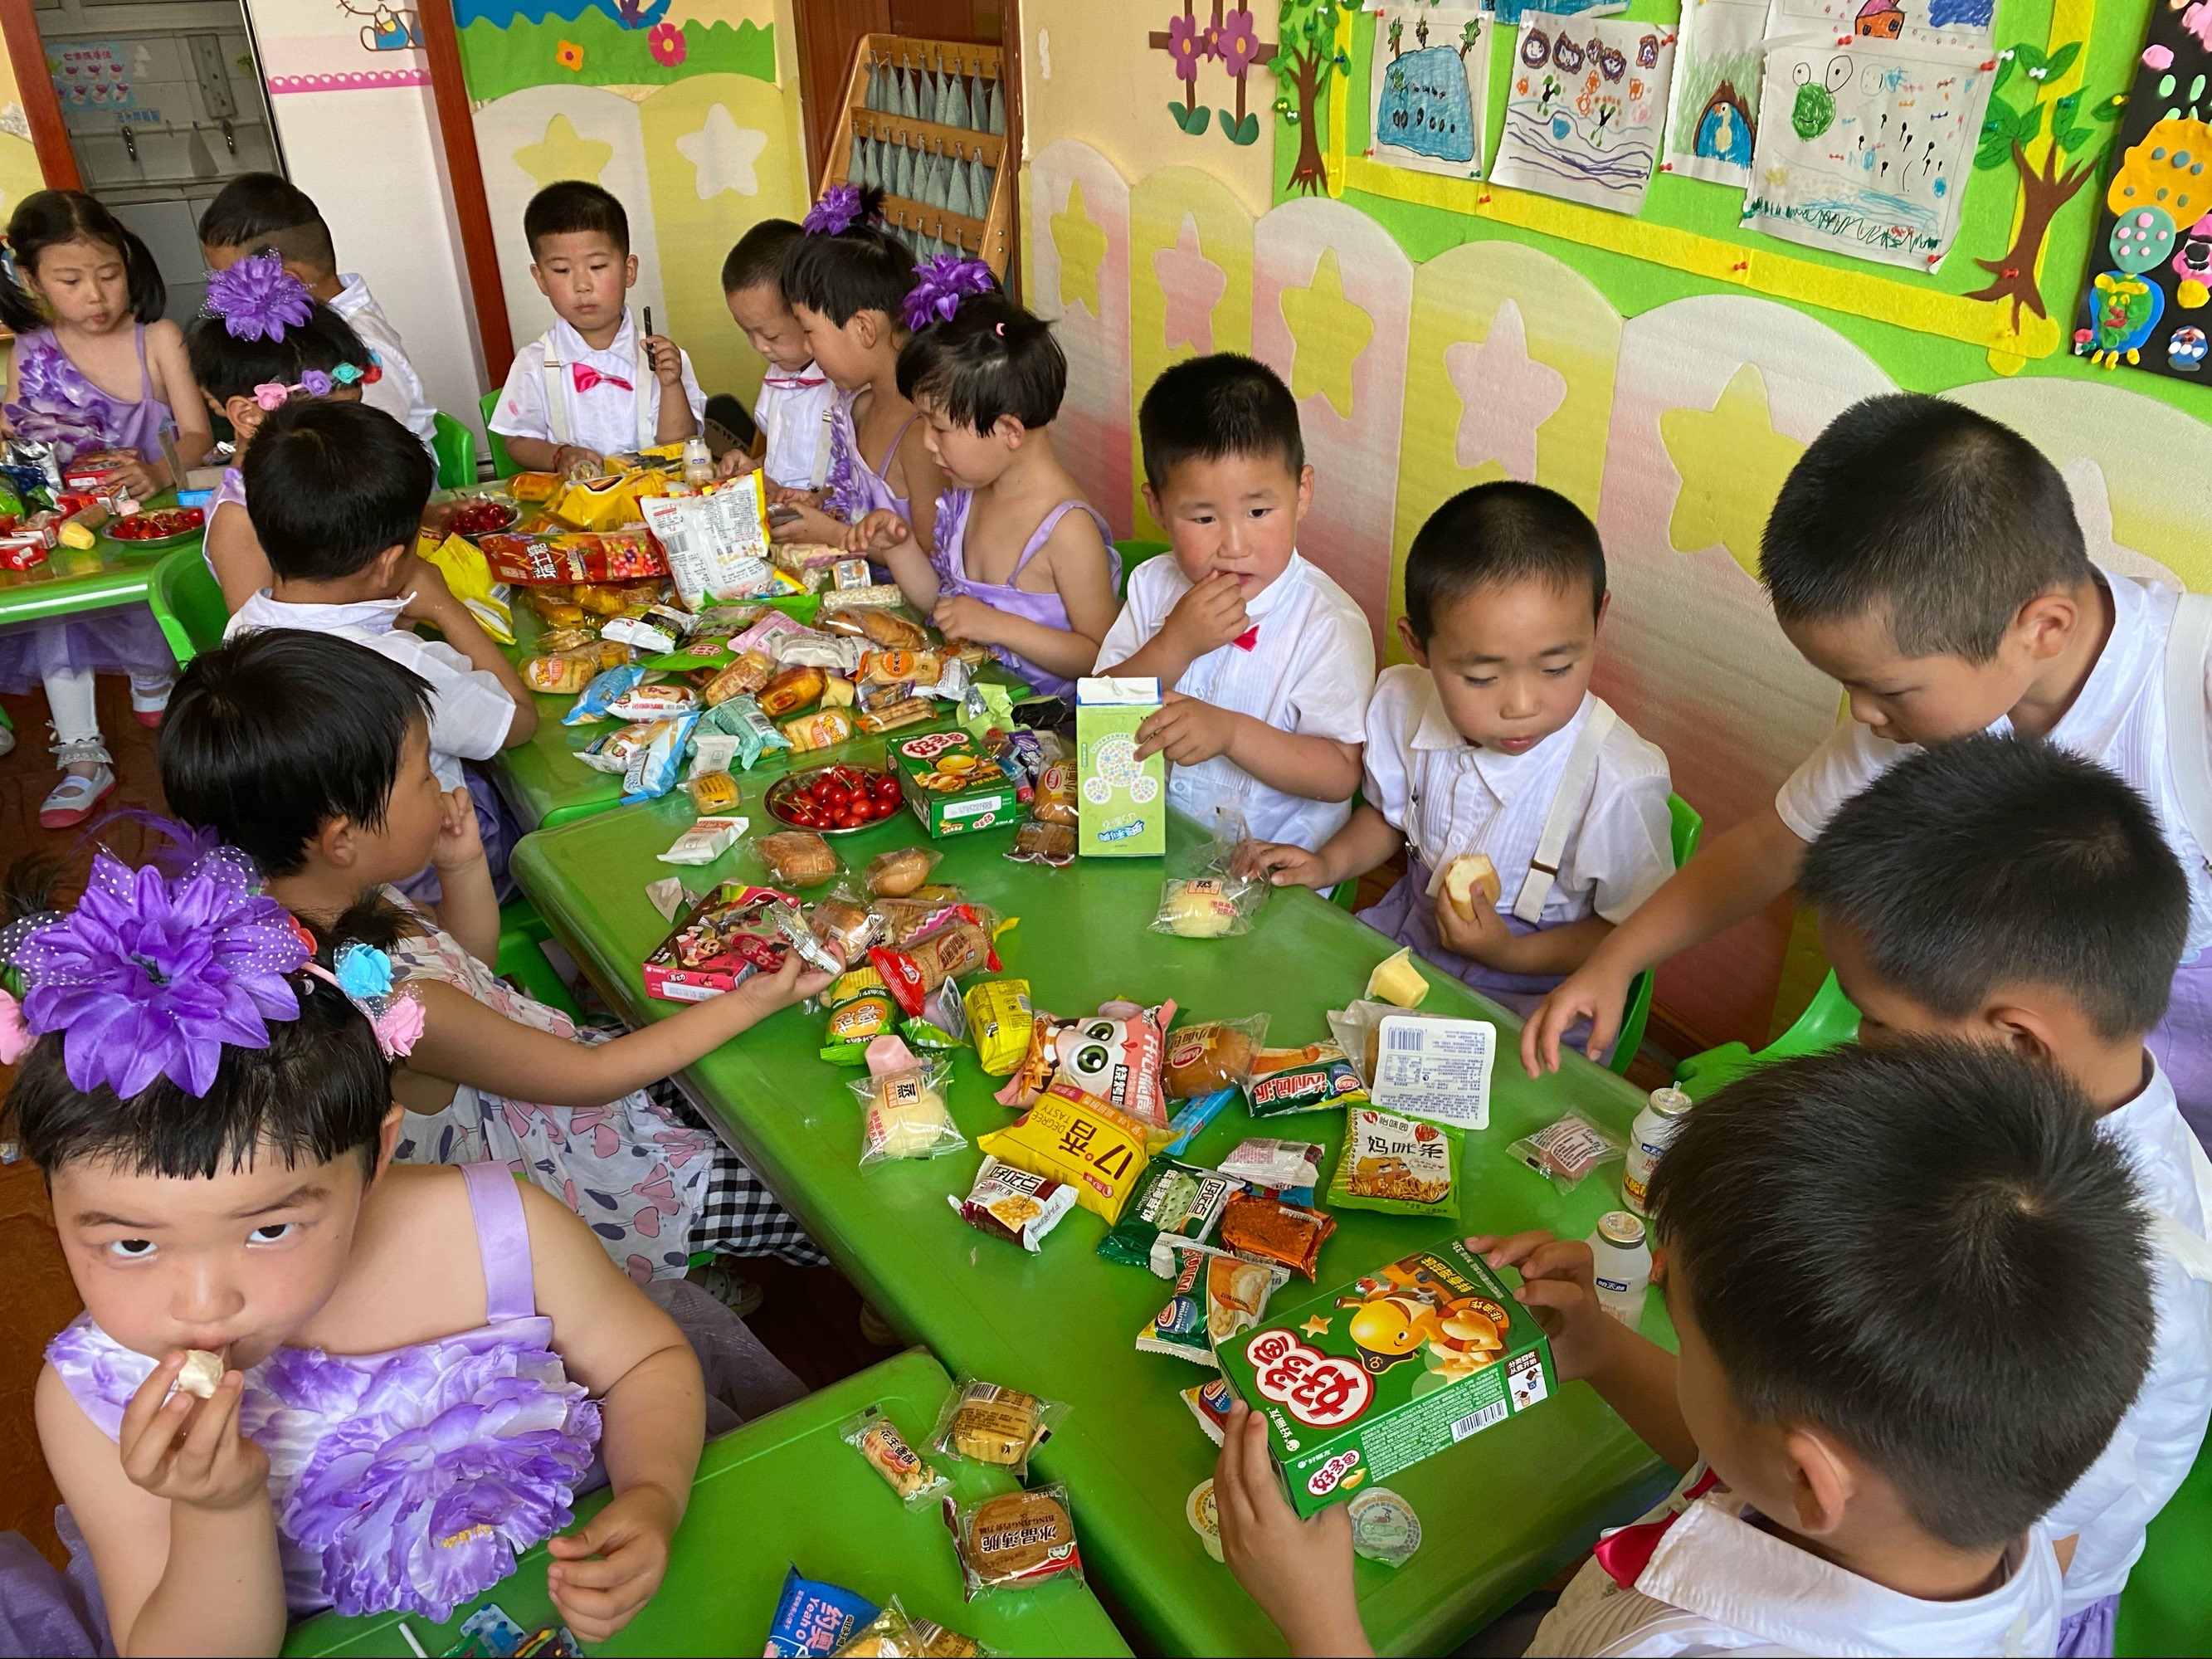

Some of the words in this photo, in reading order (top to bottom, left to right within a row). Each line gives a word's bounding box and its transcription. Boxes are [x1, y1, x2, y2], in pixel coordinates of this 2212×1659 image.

[528, 543, 553, 579] 瑞士糖
[907, 734, 964, 756] 好多鱼
[1065, 764, 1076, 789] 小面包
[1098, 821, 1144, 842] 奥利奥
[834, 1005, 883, 1033] 薯惑
[897, 1081, 916, 1099] 蒸
[1255, 1072, 1326, 1104] 达利园派
[1031, 1112, 1065, 1132] DEGREE
[1041, 1105, 1070, 1123] TASTY
[1367, 1134, 1442, 1159] 妈咪条
[987, 1165, 1043, 1193] 好吃点
[1191, 1179, 1220, 1218] 好吃点
[1420, 1254, 1474, 1295] 鲜香海苔味
[1469, 1297, 1503, 1323] 非油炸
[1508, 1351, 1536, 1368] 分类回收
[1510, 1359, 1537, 1375] 从我开始
[1254, 1335, 1358, 1419] 好多鱼
[1269, 1408, 1291, 1443] 好丽友
[1313, 1452, 1358, 1492] 好多鱼
[979, 1524, 1059, 1554] 冰晶薄脆
[801, 1596, 821, 1628] Yeah
[795, 1628, 807, 1641] O
[805, 1601, 845, 1654] 约奥
